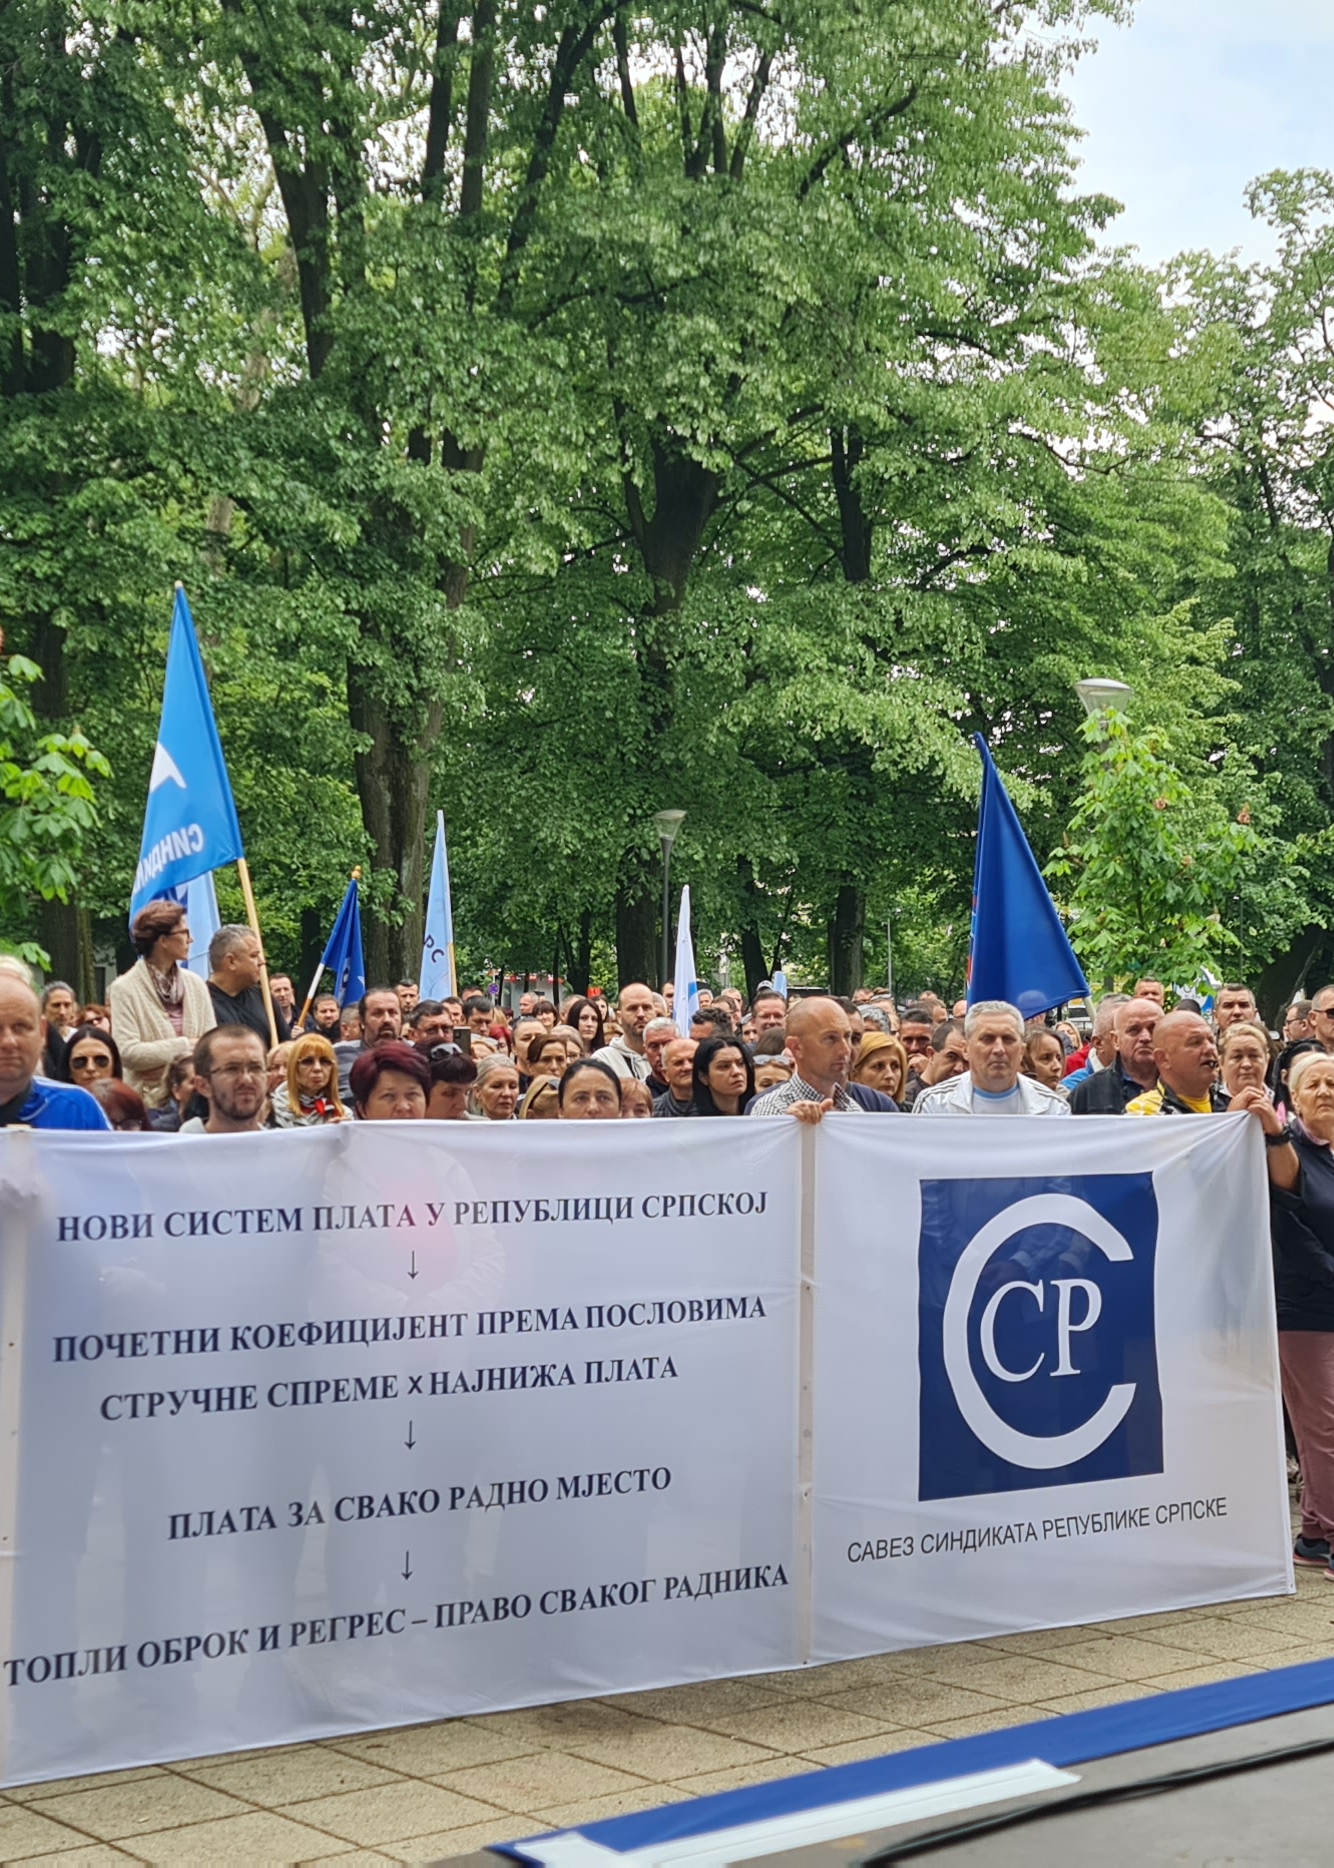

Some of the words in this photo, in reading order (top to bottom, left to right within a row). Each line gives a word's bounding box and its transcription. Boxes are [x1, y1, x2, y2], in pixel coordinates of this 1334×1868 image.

[57, 1213, 154, 1242] НОВИ
[163, 1207, 305, 1239] СИСТЕМ
[312, 1202, 417, 1231] ПЛАТА
[425, 1202, 446, 1227] У
[454, 1196, 634, 1226] РЕПУБЛИЦИ
[641, 1191, 769, 1219] СРПСКОЈ
[53, 1327, 221, 1363] ПОЧЕТНИ
[230, 1313, 469, 1352] КОЕФИЦИЈЕНТ
[476, 1306, 580, 1336] ПРЕМА
[585, 1295, 767, 1329] ПОСЛОВИМА
[100, 1384, 258, 1421] СТРУЧНЕ
[267, 1374, 399, 1408] СПРЕМЕ
[428, 1363, 577, 1397] НАЈНИЖА
[584, 1354, 679, 1385] ПЛАТА
[168, 1504, 278, 1541] ПЛАТА
[287, 1500, 325, 1528] ЗА
[334, 1488, 441, 1522] СВАКО
[448, 1478, 549, 1511] РАДНО
[556, 1466, 672, 1500] МЈЕСТО
[847, 1535, 915, 1563] САВЕЗ
[920, 1521, 1039, 1555] СИНДИКАТА
[1042, 1506, 1151, 1540] РЕПУБЛИКЕ
[1155, 1496, 1228, 1525] СРПСКЕ
[3, 1644, 128, 1687] ТОПЛИ
[136, 1628, 250, 1668] ОБРОК
[258, 1624, 281, 1652] И
[289, 1608, 406, 1648] РЕГРЕС
[434, 1594, 532, 1629] ПРАВО
[539, 1578, 657, 1615] СВАКОГ
[663, 1563, 790, 1601] РАДНИКА
